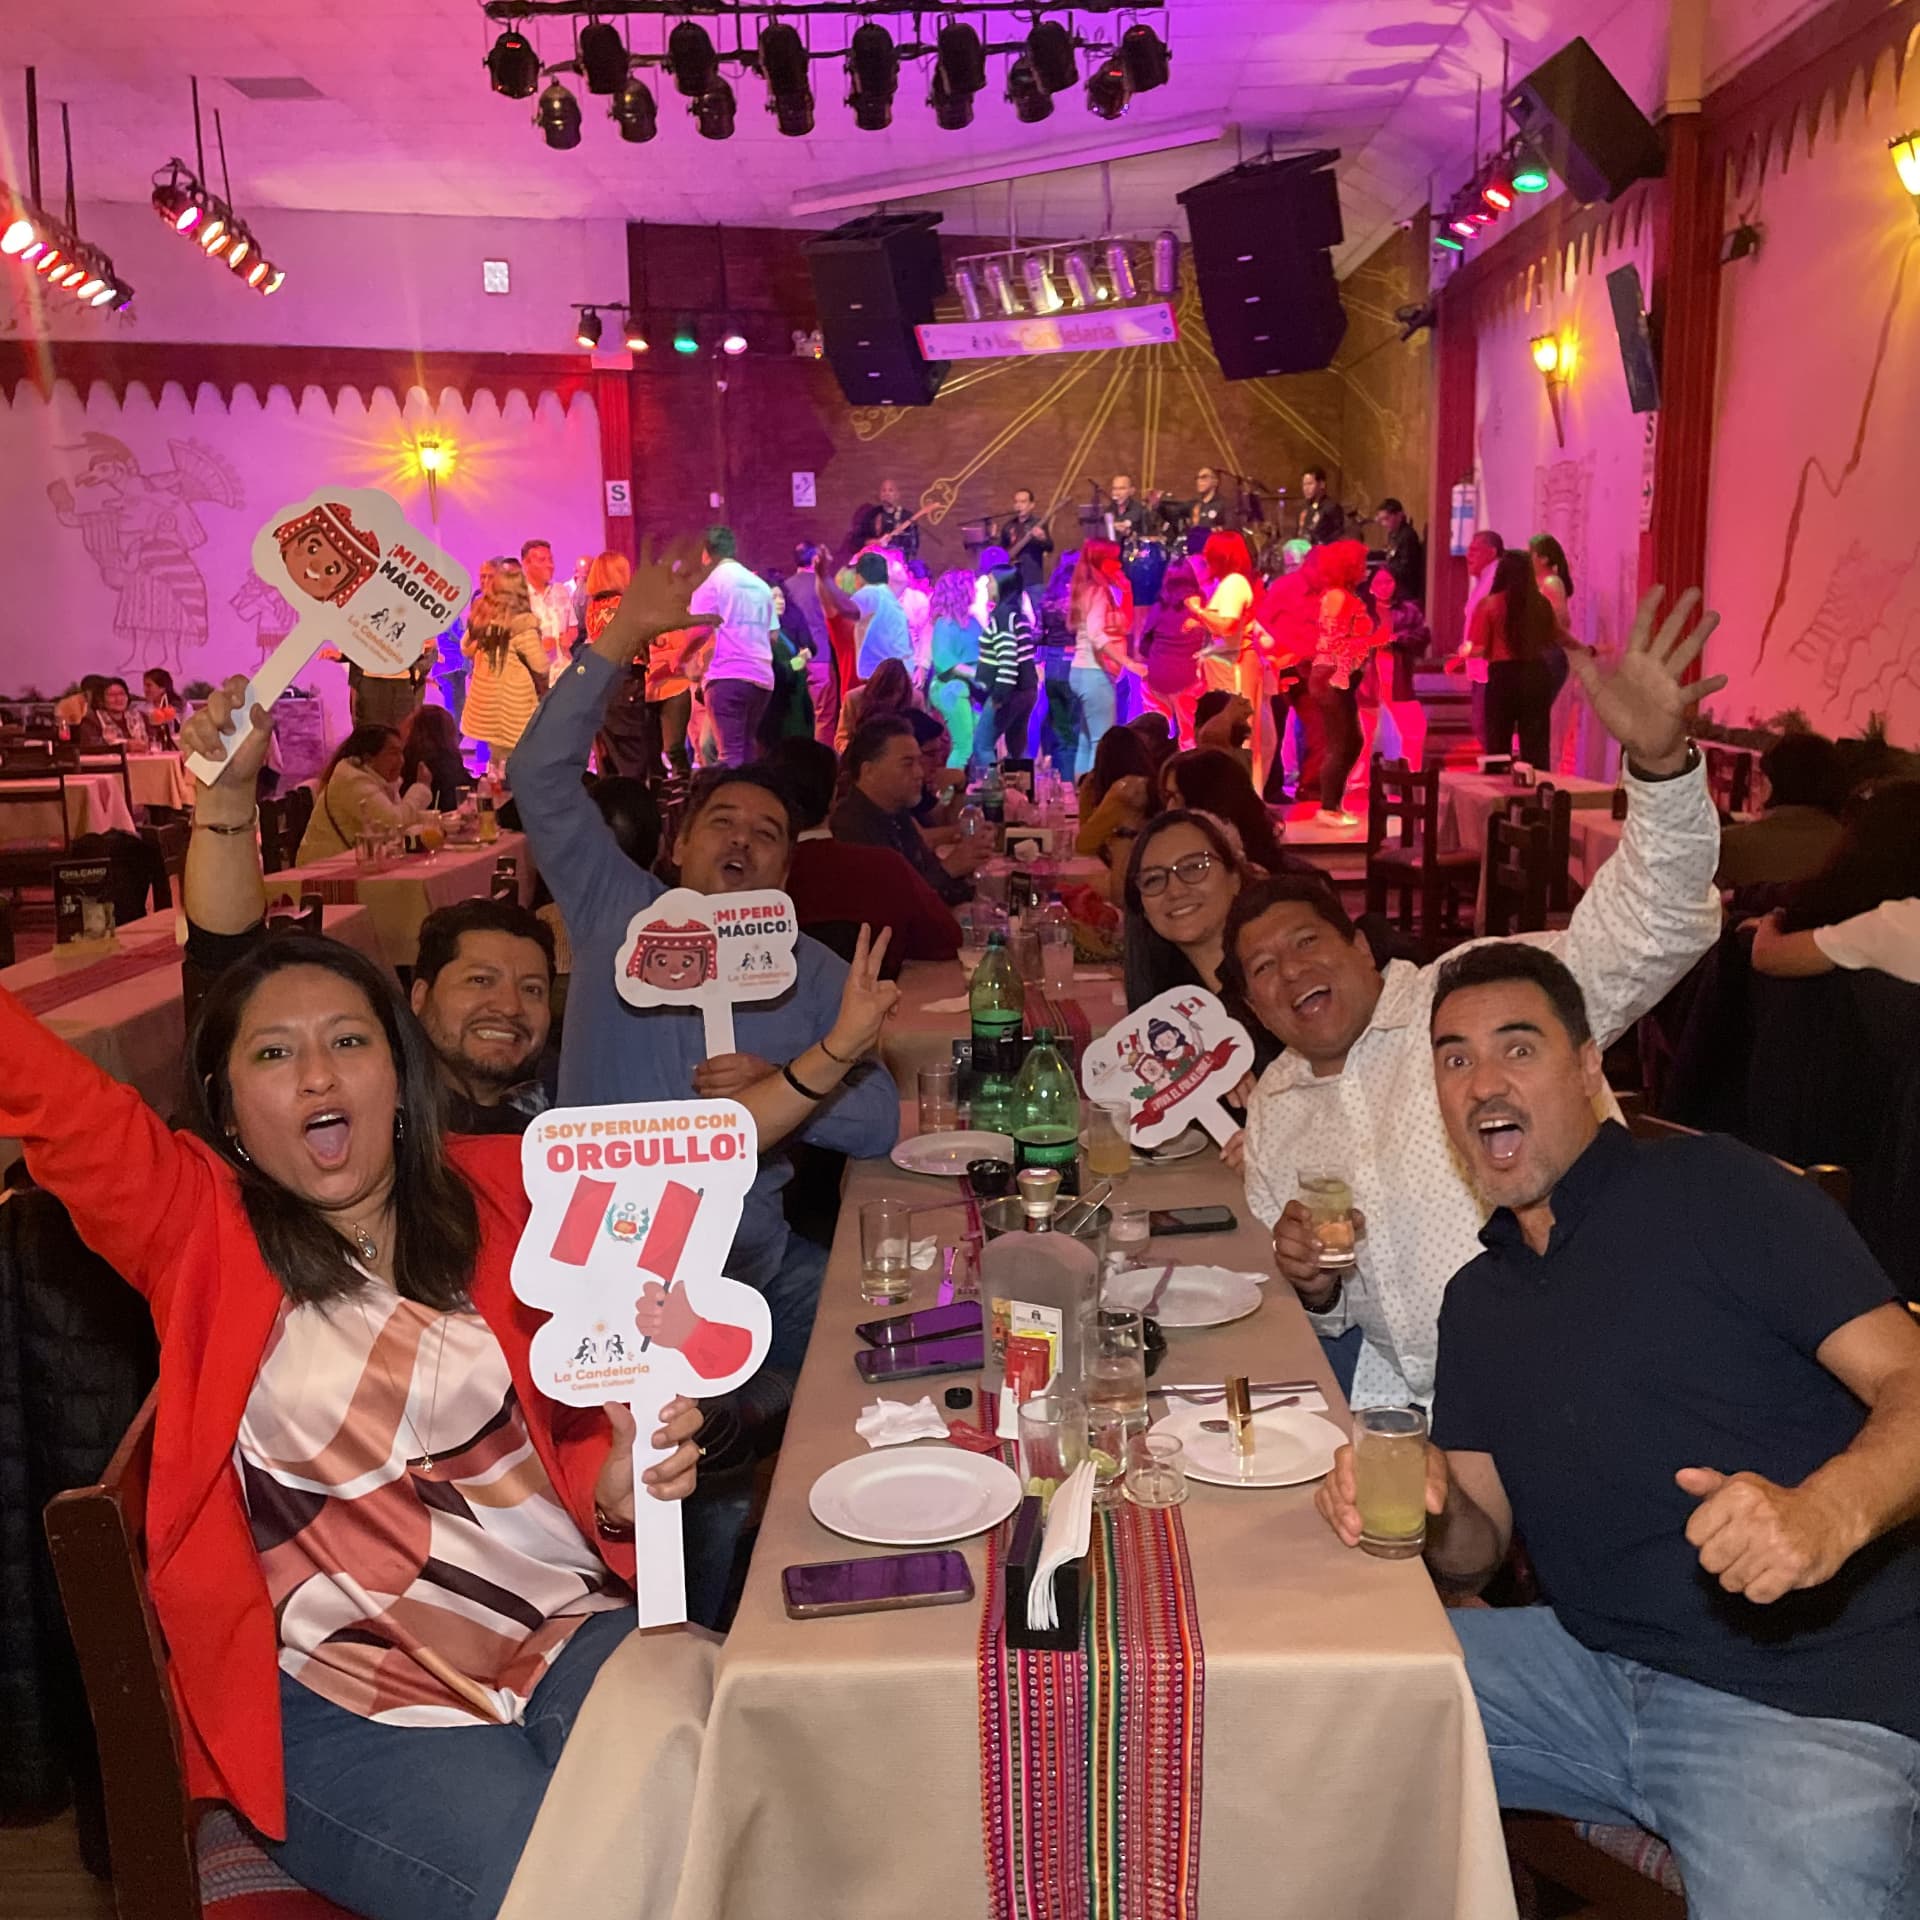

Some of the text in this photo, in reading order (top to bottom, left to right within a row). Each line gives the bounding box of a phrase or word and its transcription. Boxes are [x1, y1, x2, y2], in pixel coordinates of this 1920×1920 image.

[611, 484, 626, 501] S
[387, 543, 461, 603] ¡MI PERÚ
[379, 559, 452, 624] MÁGICO!
[713, 901, 785, 925] ¡MI PERÚ
[718, 919, 792, 938] MÁGICO!
[537, 1113, 737, 1143] ¡SOY PERUANO CON
[546, 1132, 747, 1173] ORGULLO!
[554, 1363, 650, 1383] La Candelaria
